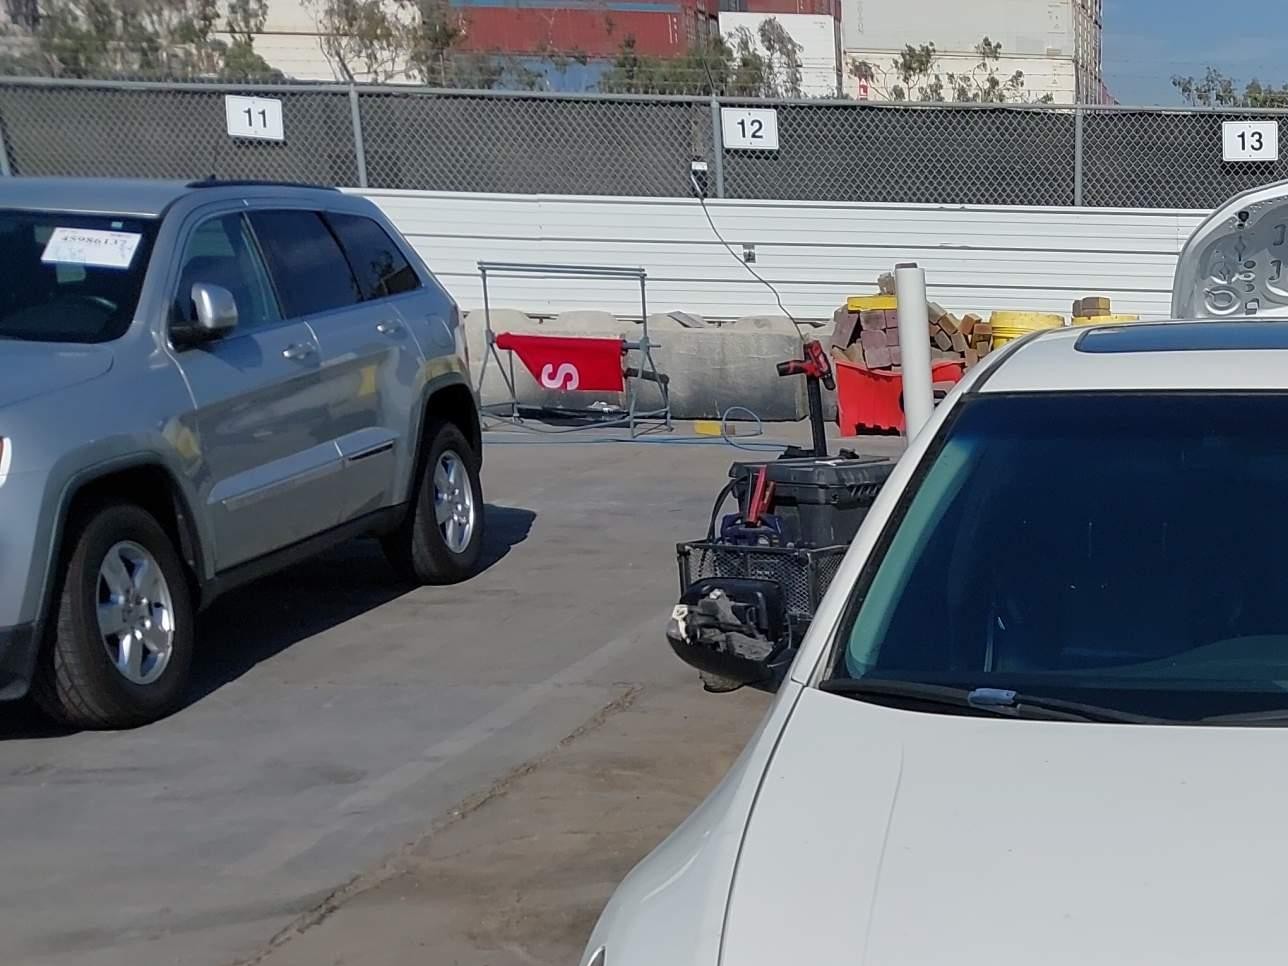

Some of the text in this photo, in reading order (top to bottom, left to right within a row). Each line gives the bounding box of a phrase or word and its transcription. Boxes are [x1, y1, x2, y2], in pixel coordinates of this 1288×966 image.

[244, 108, 267, 128] 11
[737, 119, 763, 139] 12
[1237, 131, 1264, 151] 13
